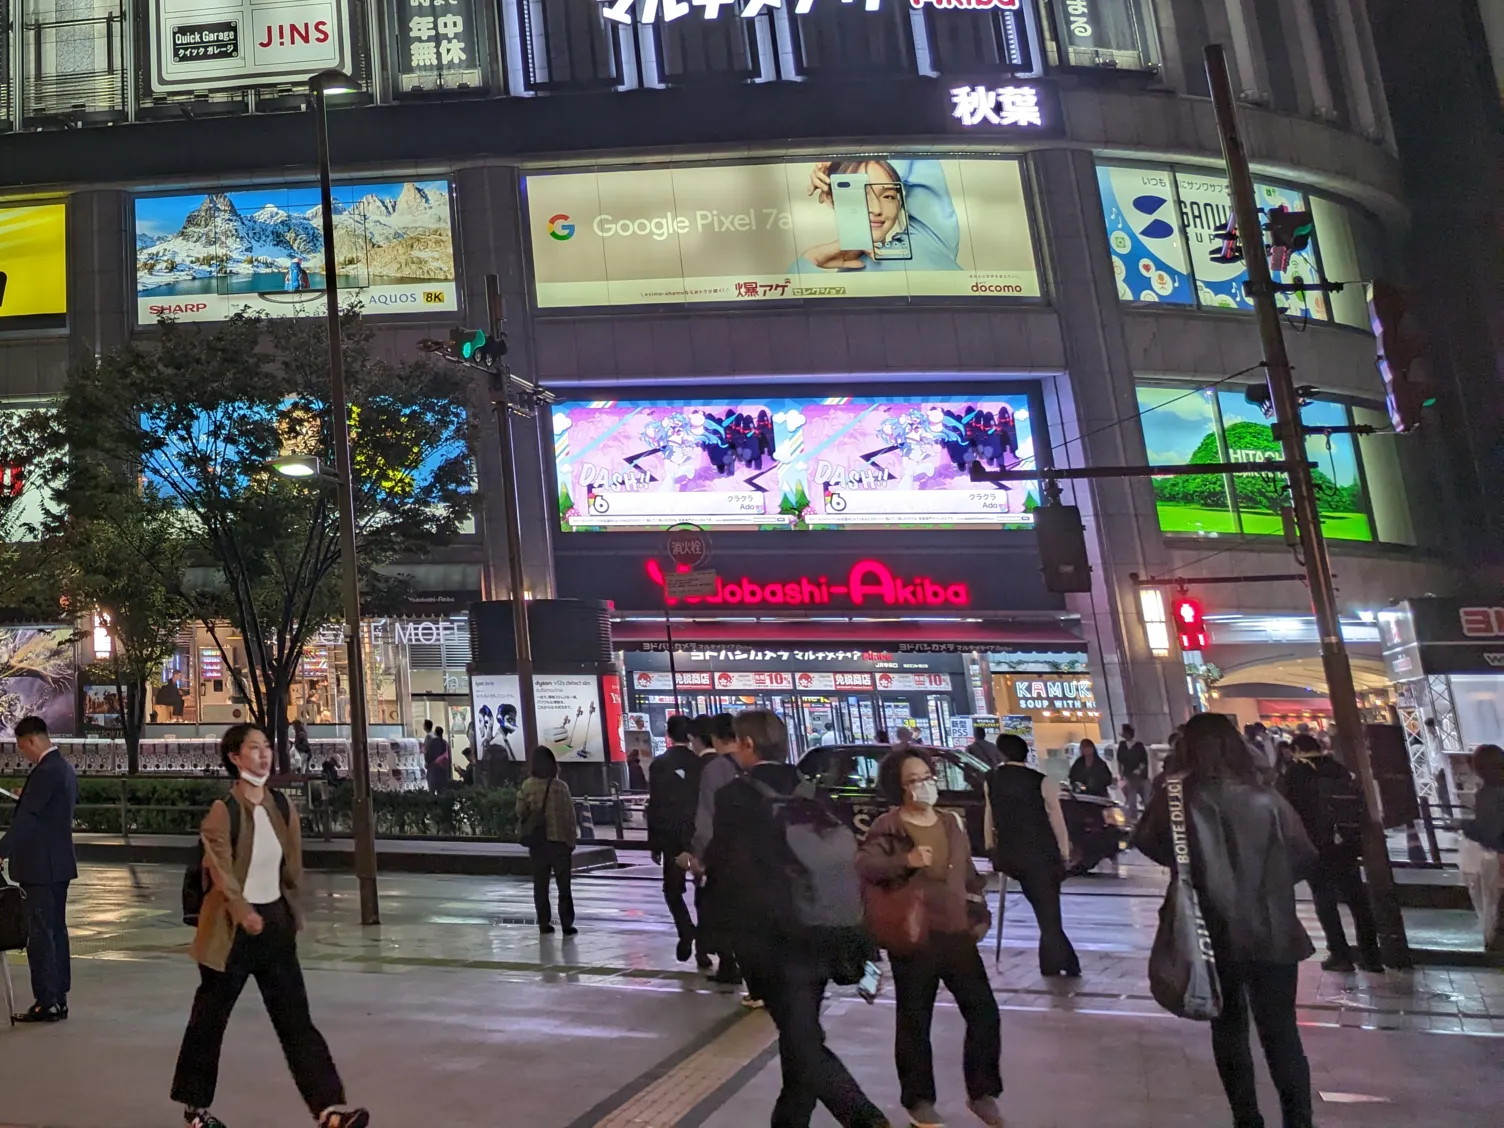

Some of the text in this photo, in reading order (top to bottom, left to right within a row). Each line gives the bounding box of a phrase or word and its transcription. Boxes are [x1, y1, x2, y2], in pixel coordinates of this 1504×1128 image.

[175, 29, 235, 44] Quick Garage
[258, 20, 330, 49] J!NS
[408, 13, 464, 41] 年中
[410, 38, 466, 67] 無休
[948, 84, 1043, 128] 秋葉
[592, 208, 792, 242] Google Pixel 7a
[734, 277, 792, 299] 爆アゲ
[970, 280, 1023, 294] docomo
[148, 292, 444, 316] SHARP AQUOS 8K
[951, 728, 969, 737] PS5
